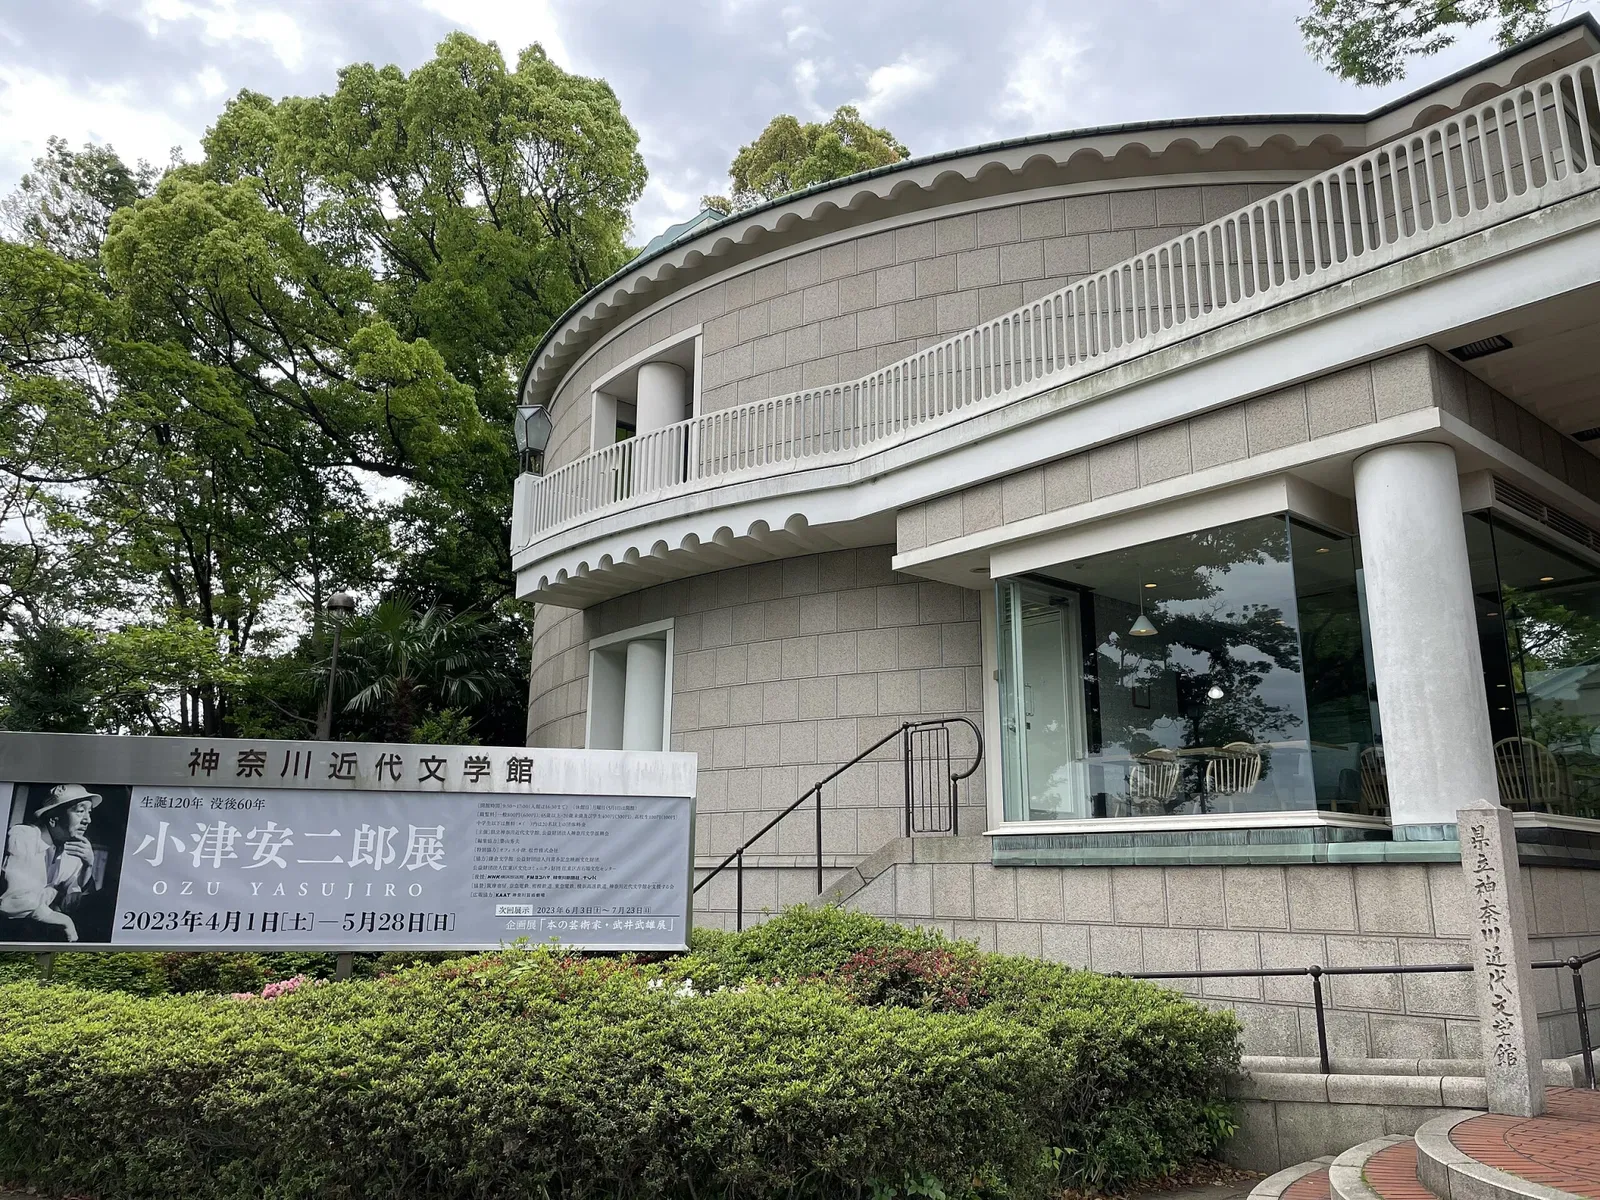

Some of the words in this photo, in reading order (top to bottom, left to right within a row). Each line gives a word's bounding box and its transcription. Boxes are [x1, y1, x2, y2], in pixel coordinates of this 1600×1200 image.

[188, 747, 534, 784] 神奈川近代文学館
[140, 795, 204, 810] 生誕120年
[210, 797, 266, 811] 没後60年
[132, 820, 448, 871] 小津安二郎展
[152, 880, 221, 896] OZU
[250, 881, 423, 900] YASUJIRO
[498, 905, 531, 915] 次回展示
[1471, 824, 1518, 1067] 県立神奈川近代文学館
